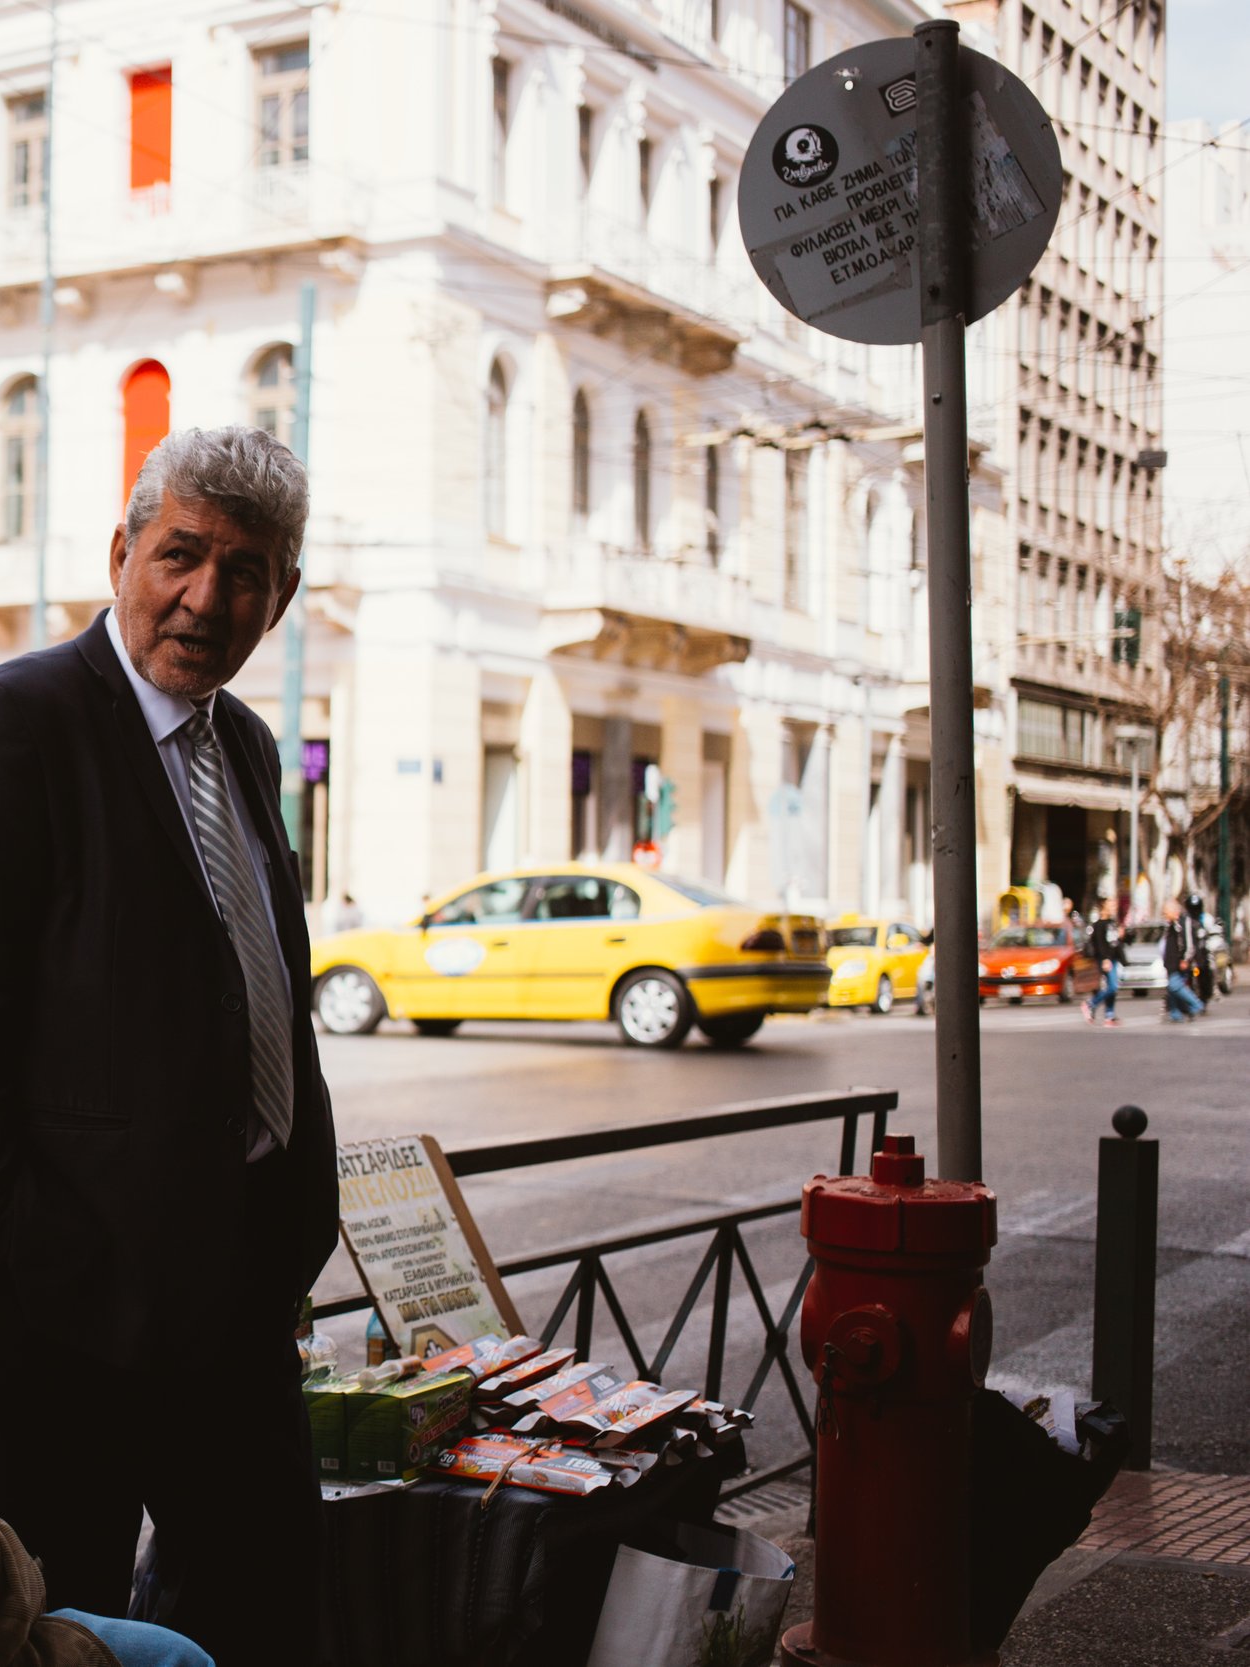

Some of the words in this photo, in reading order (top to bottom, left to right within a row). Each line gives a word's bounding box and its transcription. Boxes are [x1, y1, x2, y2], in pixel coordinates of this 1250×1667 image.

[798, 181, 839, 211] ΚΑΘΕ
[840, 162, 884, 192] ΖΗΜΙΑ
[790, 219, 857, 258] ΦΥΛΑΚΙΣΗ
[860, 197, 901, 227] ΜΕΧΡΙ
[823, 238, 871, 267] ΒΙΟΤΑΛ
[440, 1453, 457, 1464] 30
